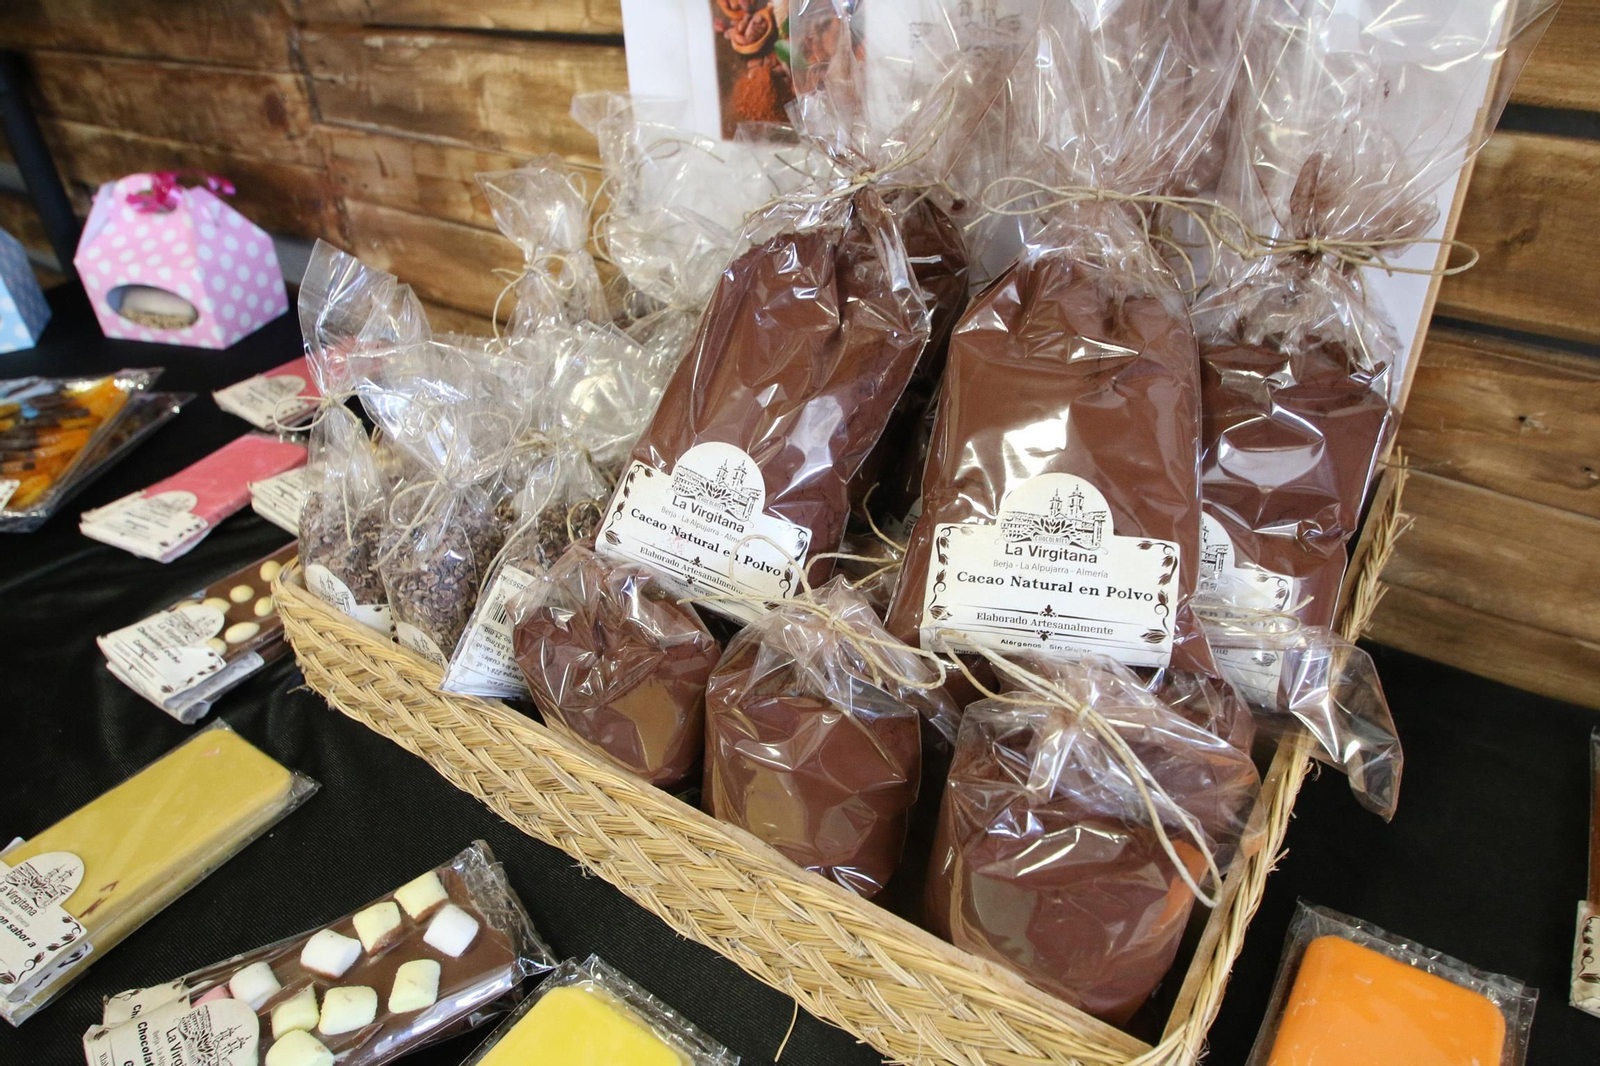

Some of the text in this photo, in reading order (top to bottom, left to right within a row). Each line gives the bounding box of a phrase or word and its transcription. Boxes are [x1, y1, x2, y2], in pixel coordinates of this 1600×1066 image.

[661, 506, 677, 518] Berja
[690, 519, 720, 536] Alpujarra
[672, 495, 745, 533] La Virgitana
[631, 508, 667, 531] Cacao
[670, 525, 720, 553] Natural
[743, 555, 781, 576] Polvo
[1004, 543, 1097, 564] La Virgitana
[640, 547, 680, 568] Elaborado
[993, 559, 1109, 578] Berja La Alpujarra Almería
[957, 571, 1154, 601] Cacao Natural en Polvo
[976, 612, 1114, 635] Elaborado Artesanalmente
[5, 887, 38, 917] Virgitana
[6, 923, 31, 942] sabor
[166, 1026, 178, 1043] La
